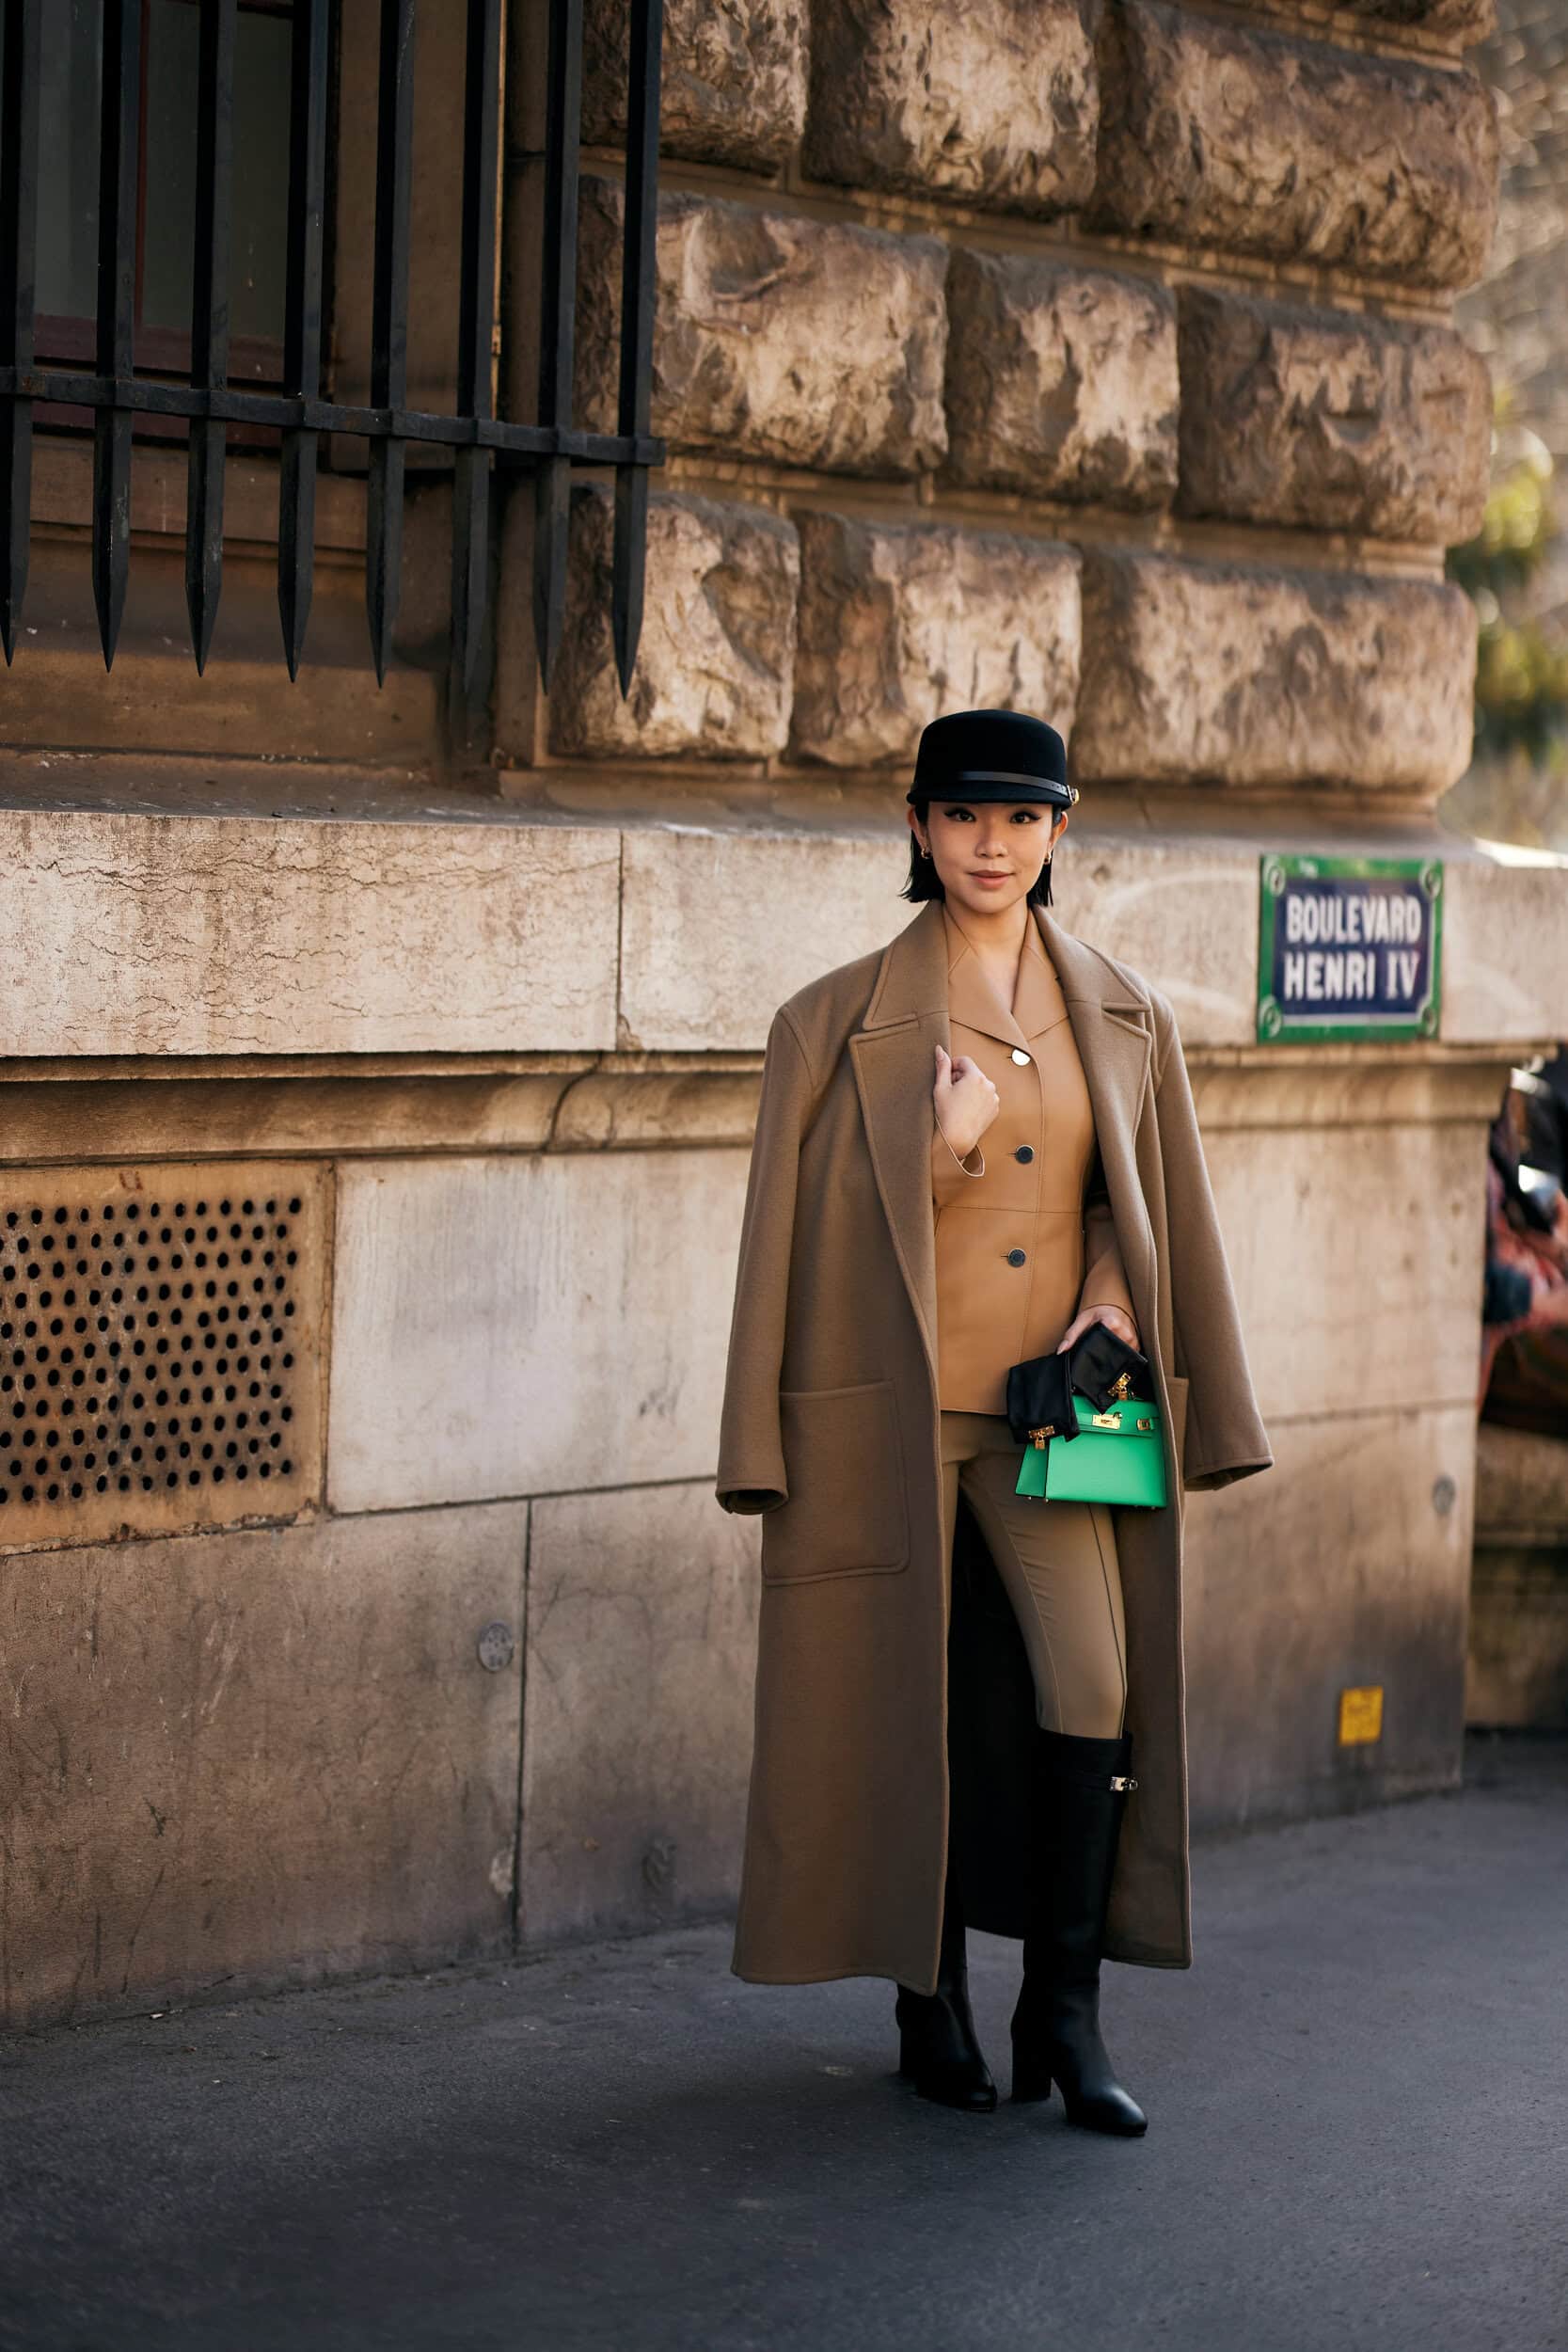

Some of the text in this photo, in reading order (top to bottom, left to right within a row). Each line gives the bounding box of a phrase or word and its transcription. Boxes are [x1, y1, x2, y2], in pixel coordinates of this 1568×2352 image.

[1287, 897, 1421, 943] BOULEVARD
[1284, 952, 1419, 999] HENRI IV
